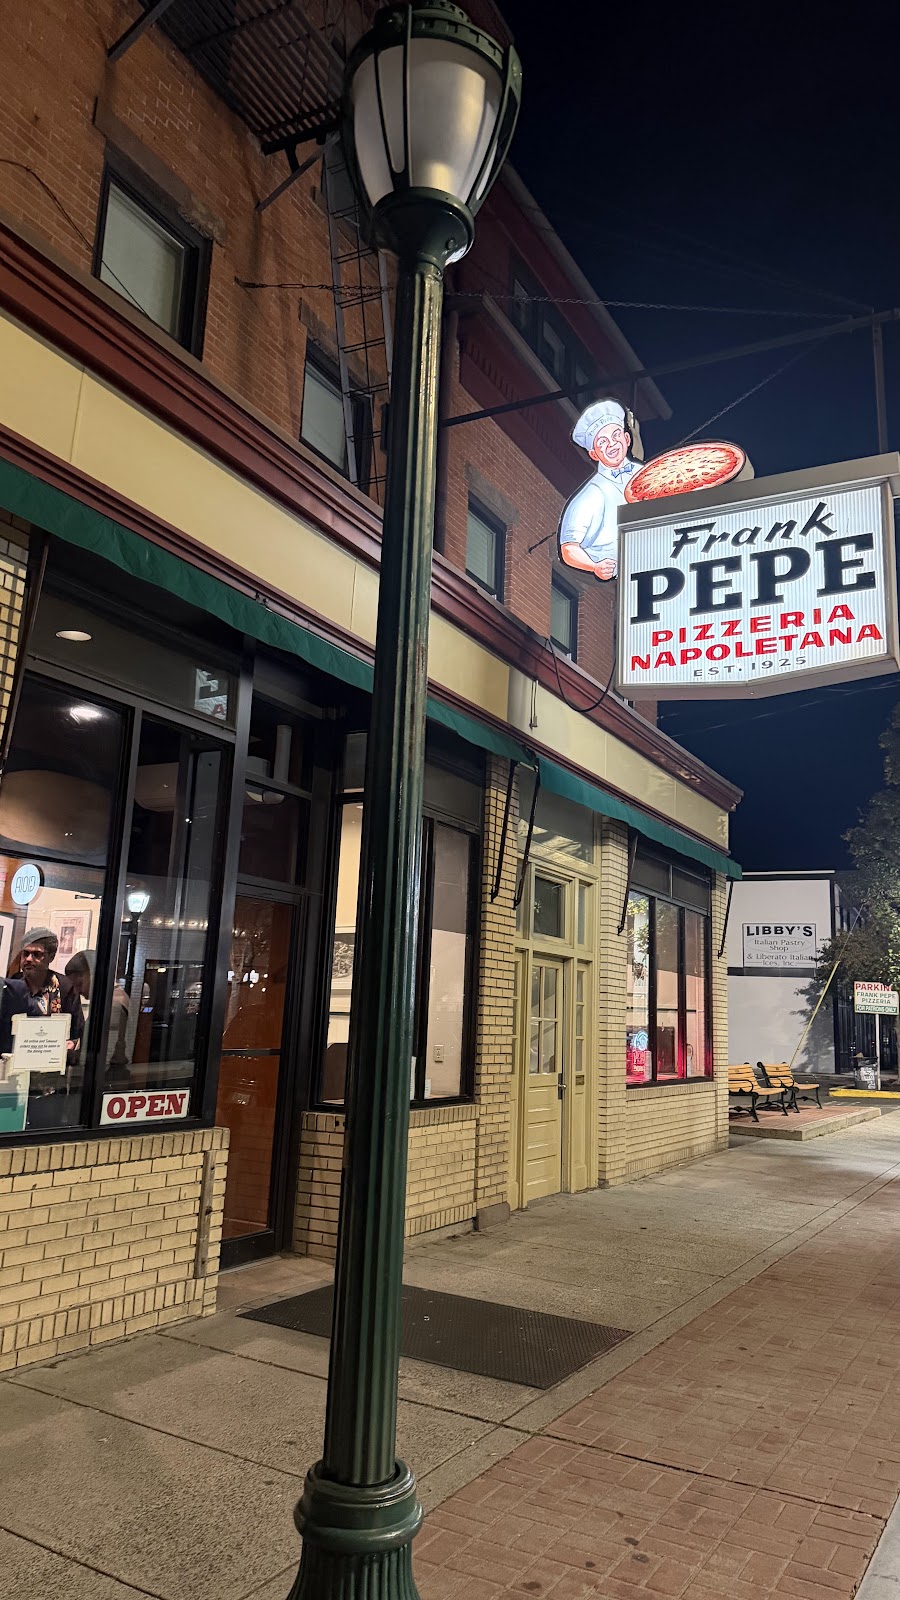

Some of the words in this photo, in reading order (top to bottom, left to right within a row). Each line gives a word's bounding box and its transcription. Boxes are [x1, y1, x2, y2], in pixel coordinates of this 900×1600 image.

[670, 502, 837, 559] Frank
[630, 533, 876, 625] PEPE
[652, 604, 855, 647] PIZZERIA
[631, 624, 884, 671] NAPOLETANA
[693, 664, 742, 677] EST.
[751, 656, 807, 670] 1925
[746, 926, 812, 936] LIBBY'S
[856, 983, 892, 992] PARKIN
[106, 1094, 186, 1119] OPEN
